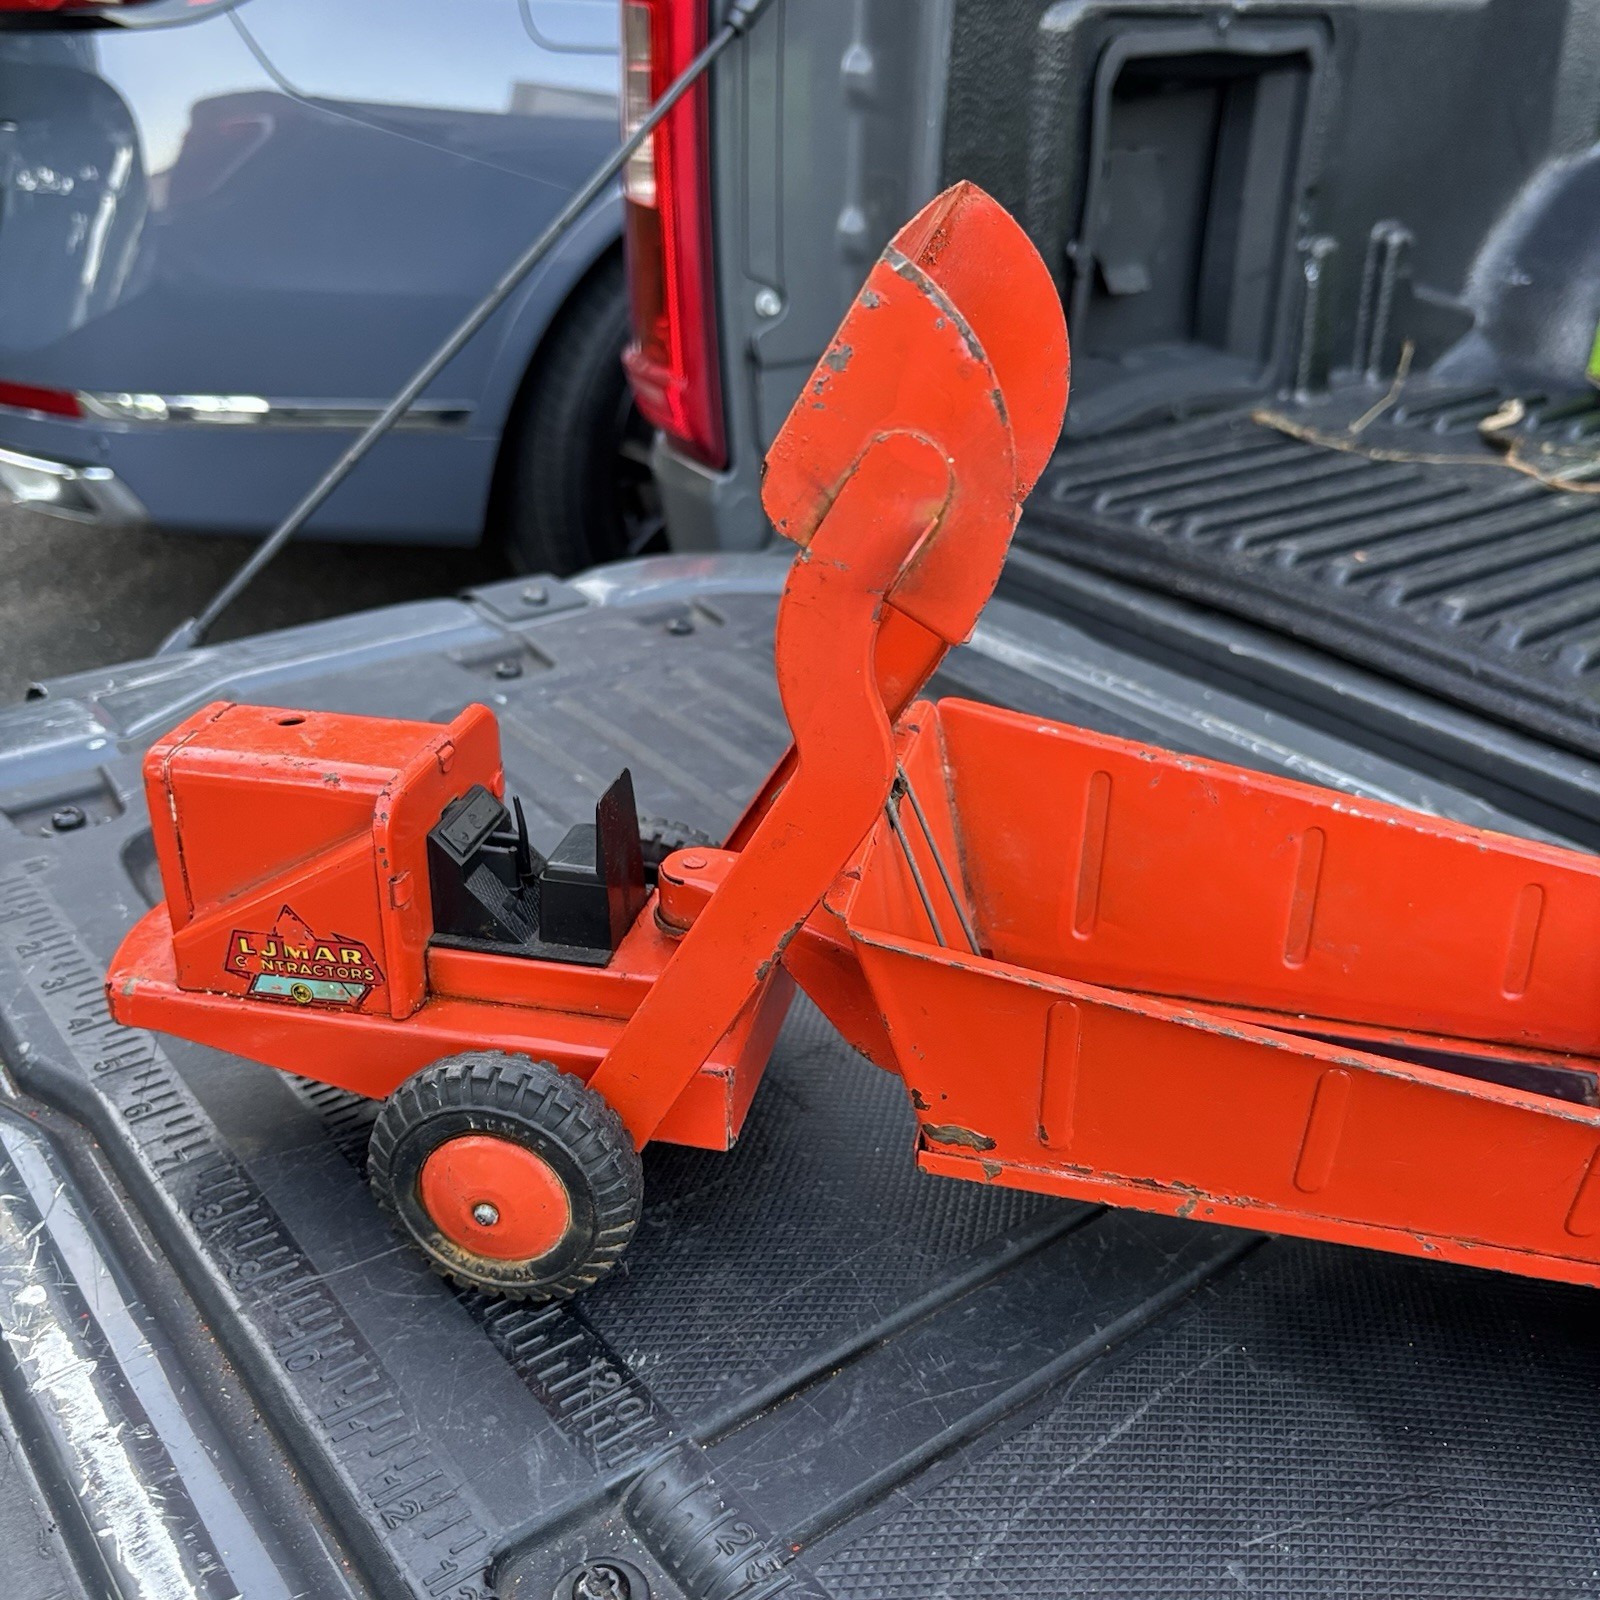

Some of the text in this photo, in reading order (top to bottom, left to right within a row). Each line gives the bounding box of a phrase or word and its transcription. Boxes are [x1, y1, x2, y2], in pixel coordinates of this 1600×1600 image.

[234, 953, 376, 982] CNTRACTORS
[16, 940, 42, 954] 2
[41, 976, 67, 990] 3
[67, 1017, 93, 1030] 4
[94, 1059, 121, 1072] 5
[123, 1102, 152, 1118] 6
[154, 1149, 188, 1167] 7
[190, 1203, 223, 1223] 8
[273, 1326, 320, 1372] 10
[367, 1473, 422, 1531] 12
[588, 1370, 783, 1582] 20 25
